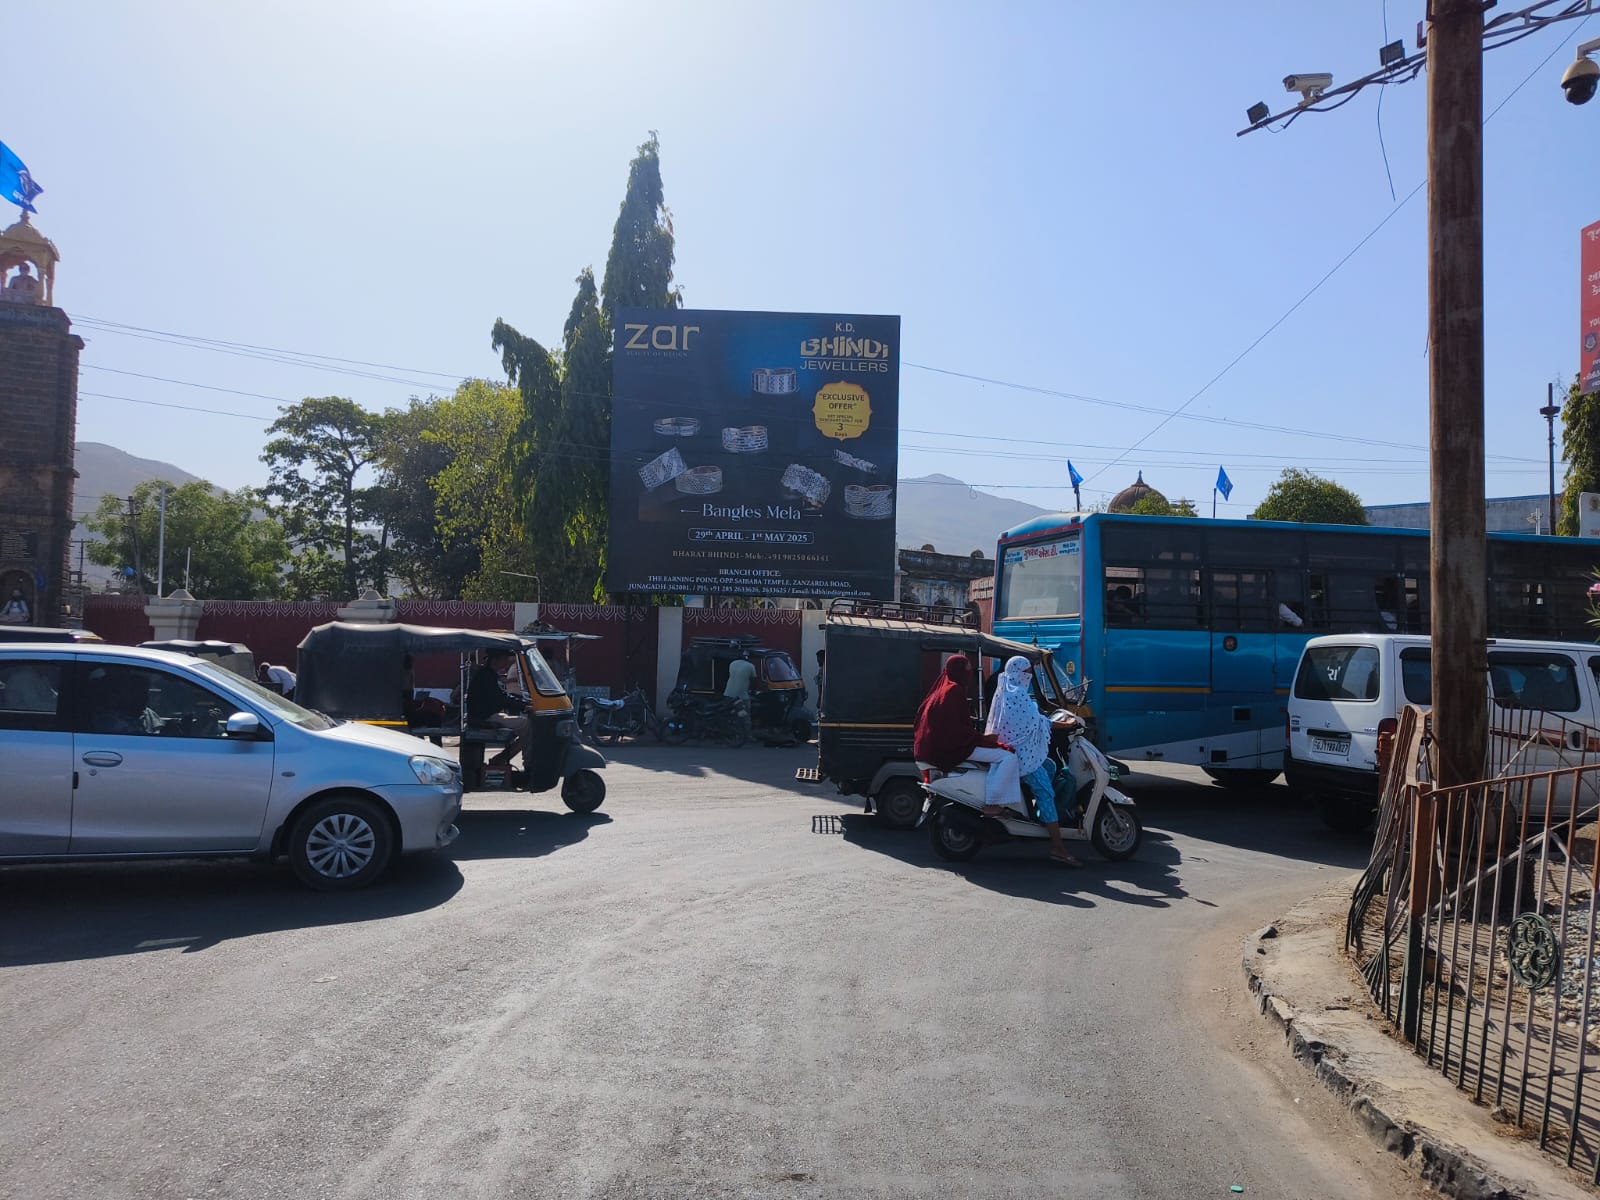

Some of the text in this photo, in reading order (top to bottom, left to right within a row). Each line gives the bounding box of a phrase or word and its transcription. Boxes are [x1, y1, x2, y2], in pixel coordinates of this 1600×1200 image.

[835, 322, 855, 333] K.D.
[624, 323, 700, 351] zar
[799, 360, 889, 373] JEWELLERS
[837, 422, 844, 431] 3
[703, 503, 802, 522] Bangles Mela
[695, 530, 713, 539] 29th
[715, 531, 744, 540] APRIL
[751, 532, 763, 541] 1st
[764, 533, 786, 542] MAY
[787, 534, 808, 542] 2025
[672, 550, 705, 558] BHARAT
[719, 569, 751, 577] BRANCH
[663, 576, 695, 584] EARNING
[793, 579, 830, 588] ZANZARDA
